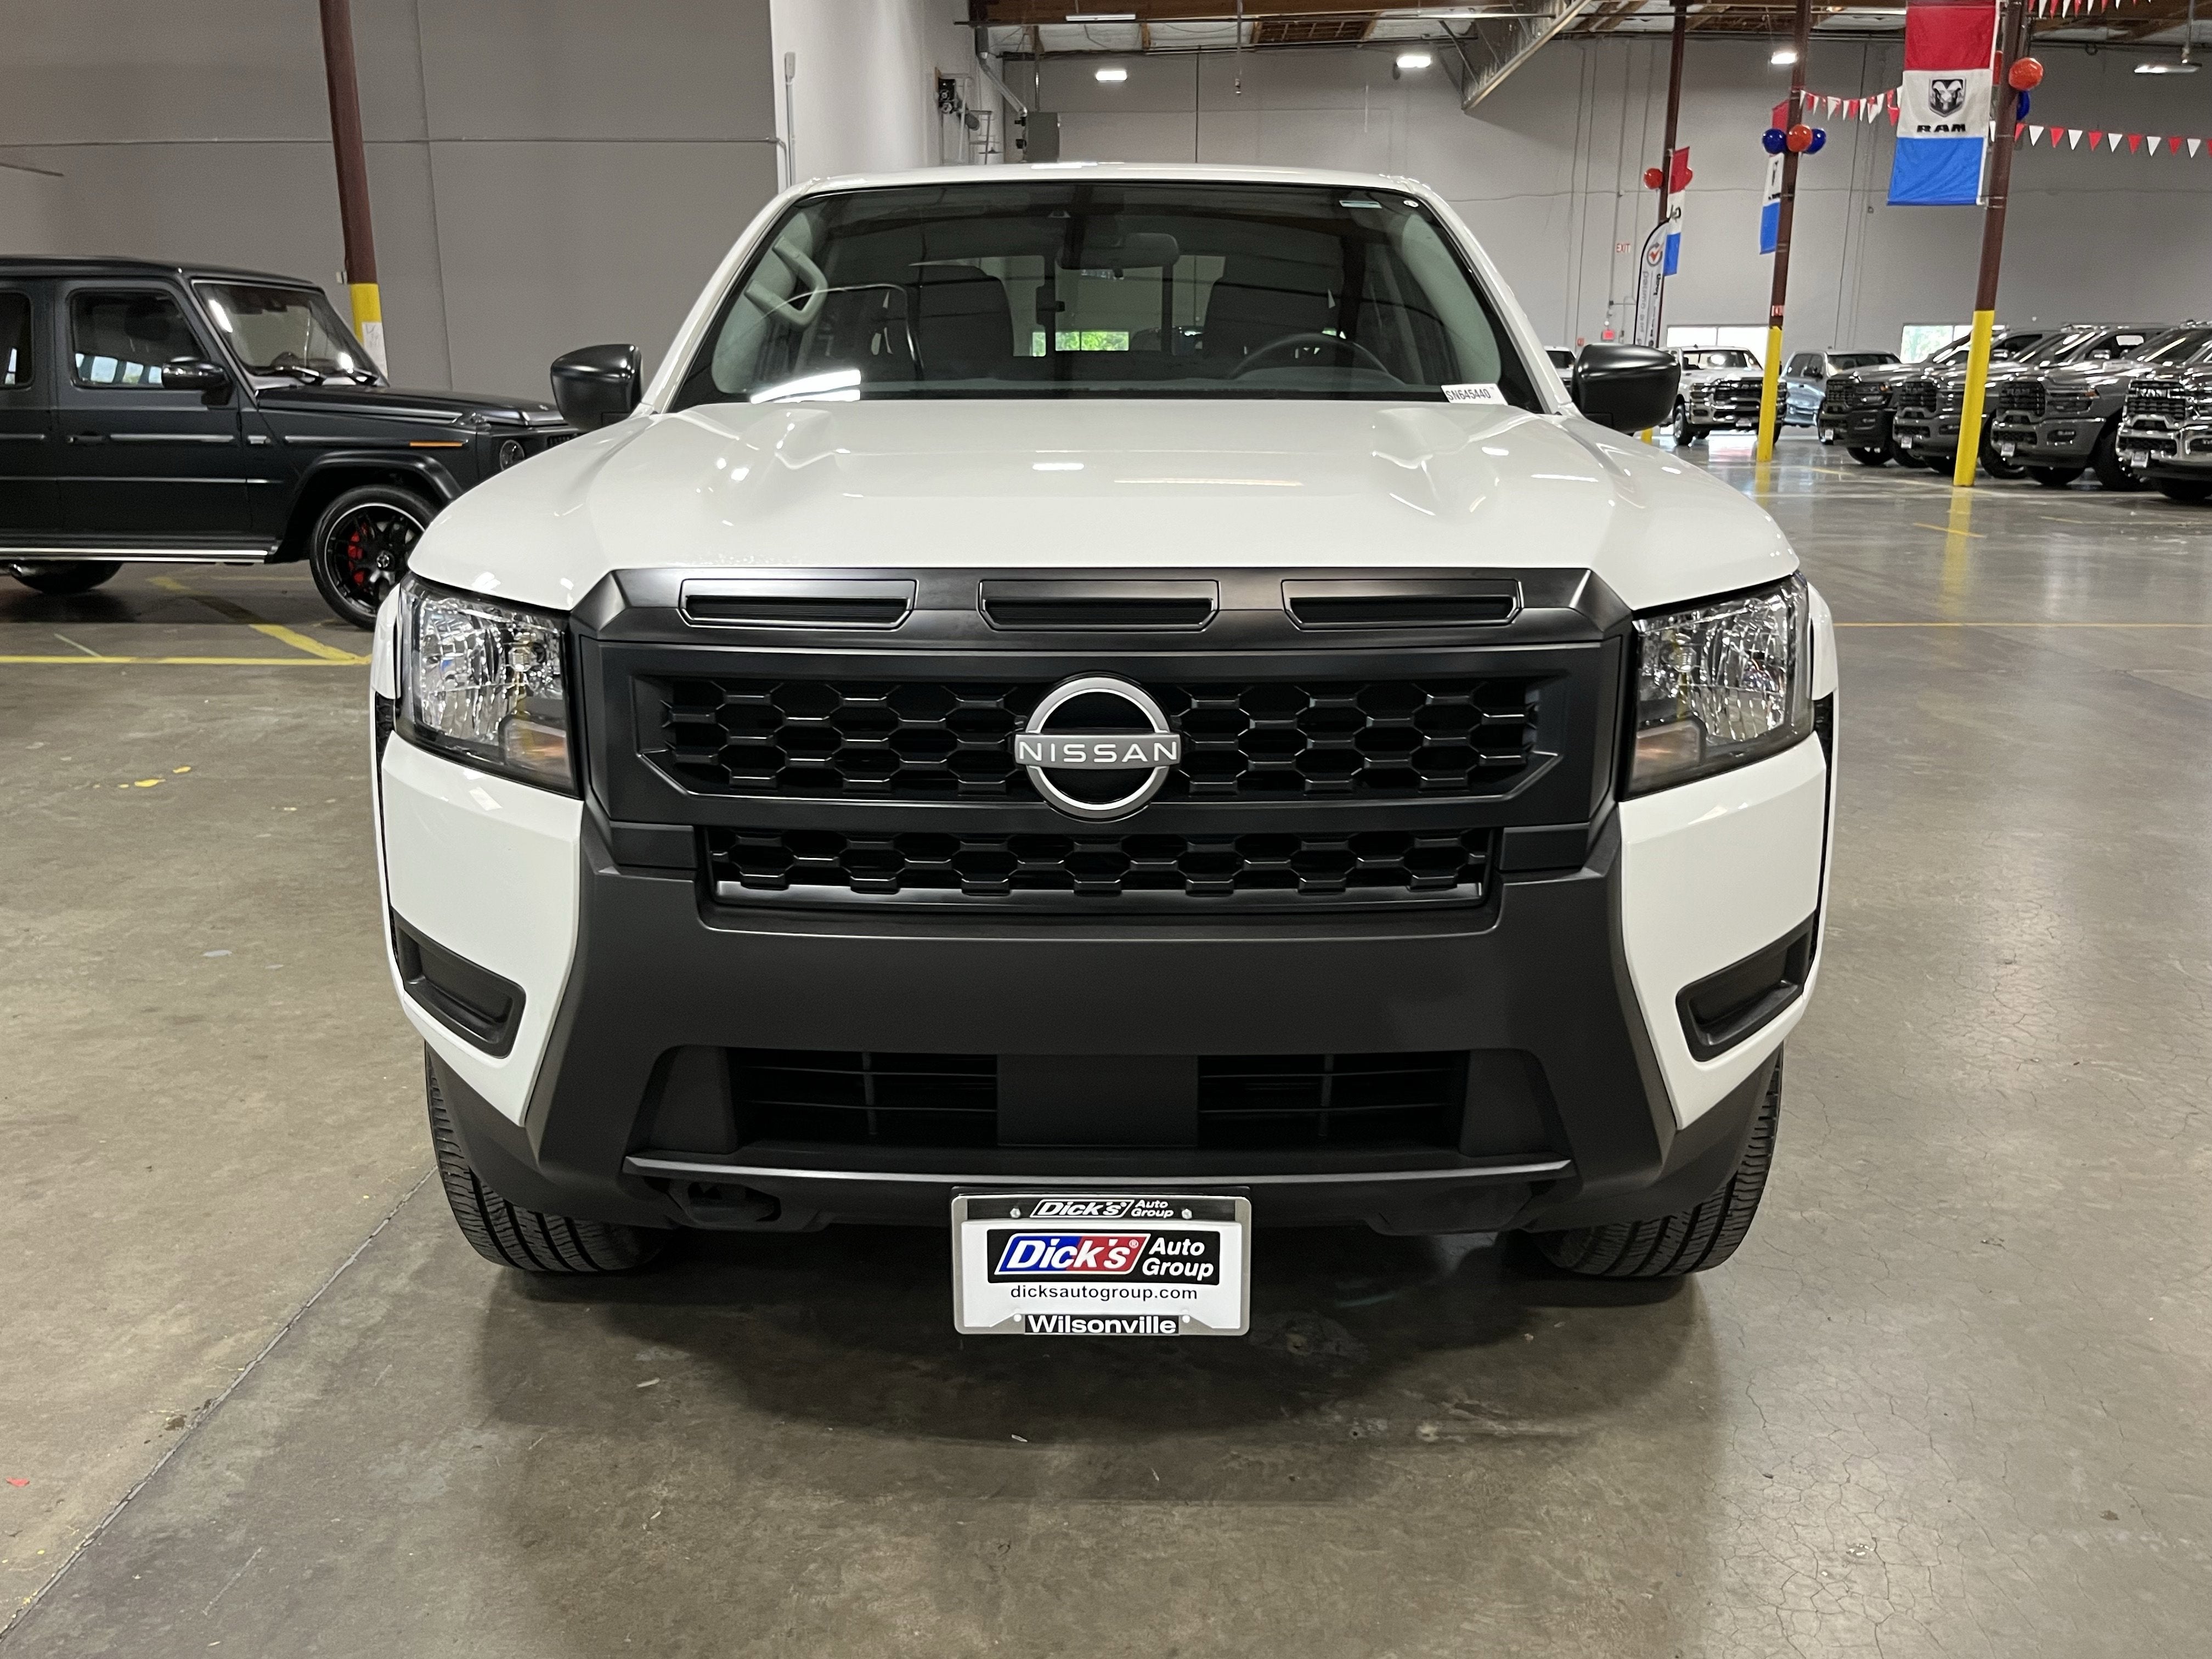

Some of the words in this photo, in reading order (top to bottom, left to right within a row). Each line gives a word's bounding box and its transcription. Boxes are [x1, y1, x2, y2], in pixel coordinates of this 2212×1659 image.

[1917, 123, 1966, 133] RAM
[1616, 243, 1630, 253] EXIT
[1445, 388, 1491, 400] SN645440
[1019, 741, 1177, 763] NISSAN
[1037, 1201, 1121, 1216] Dick's
[1135, 1199, 1169, 1208] Auto
[1131, 1208, 1174, 1218] Group
[1007, 1238, 1131, 1269] Dick's
[1149, 1237, 1205, 1256] Auto
[1142, 1257, 1214, 1281] Group
[1011, 1285, 1198, 1302] dicksautogroup.com
[1028, 1315, 1177, 1334] Wilsonville
